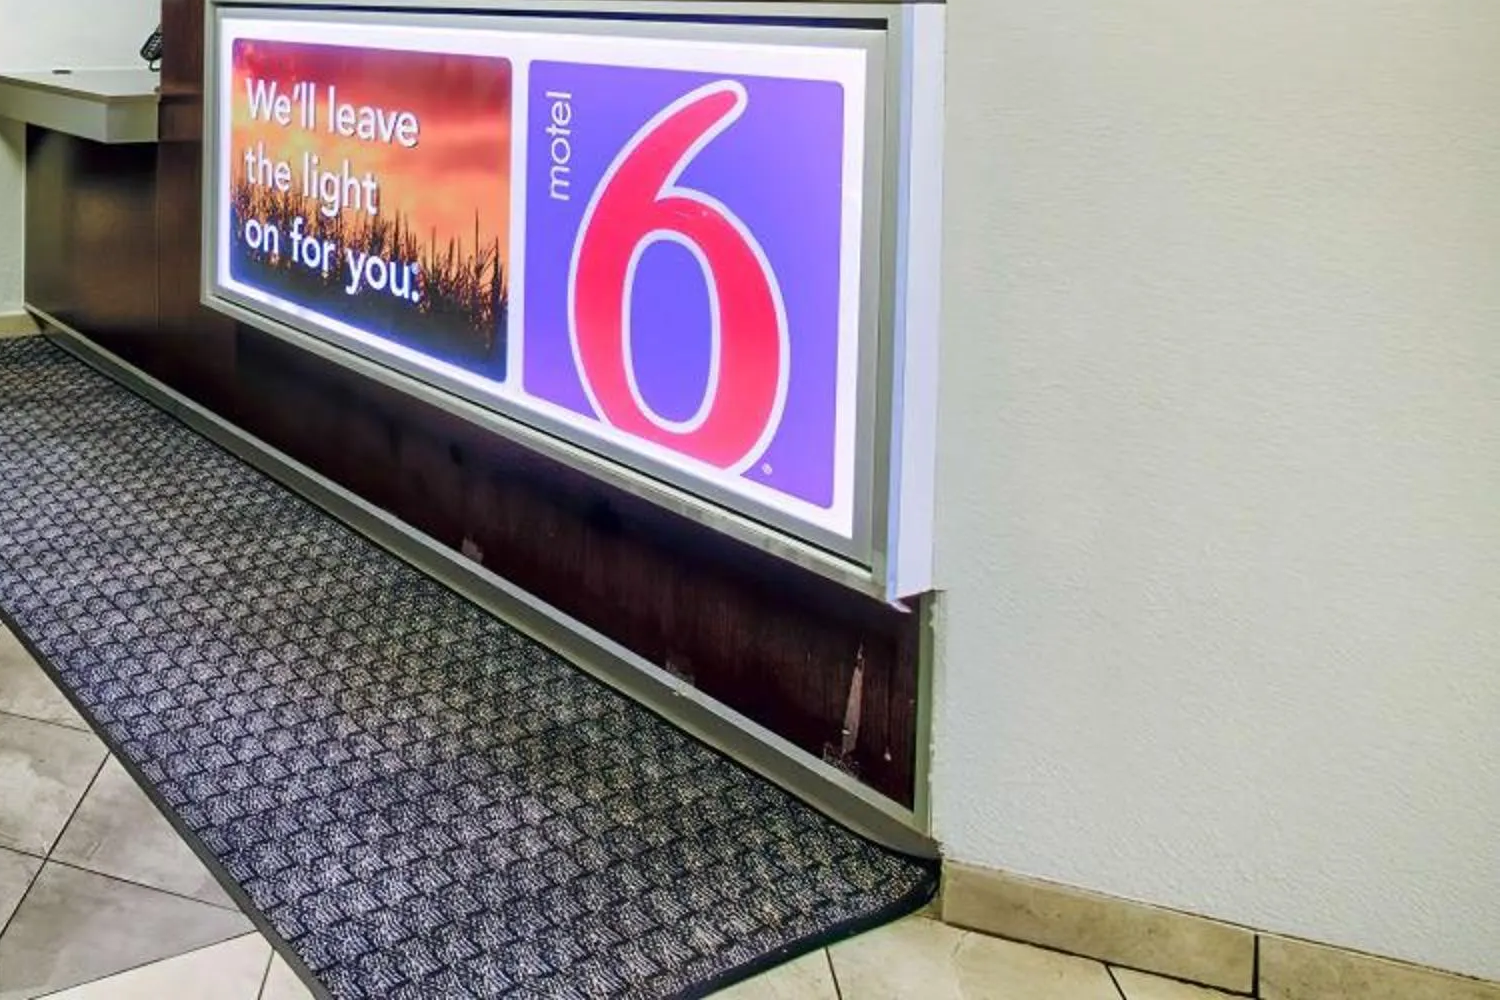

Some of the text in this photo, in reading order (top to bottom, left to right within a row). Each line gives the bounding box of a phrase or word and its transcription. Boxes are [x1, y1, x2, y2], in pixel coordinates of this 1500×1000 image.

[245, 77, 420, 148] We'll leave
[545, 90, 573, 201] motel
[244, 140, 379, 217] the light
[244, 218, 279, 256] on
[290, 215, 336, 273] for
[568, 79, 791, 477] 6
